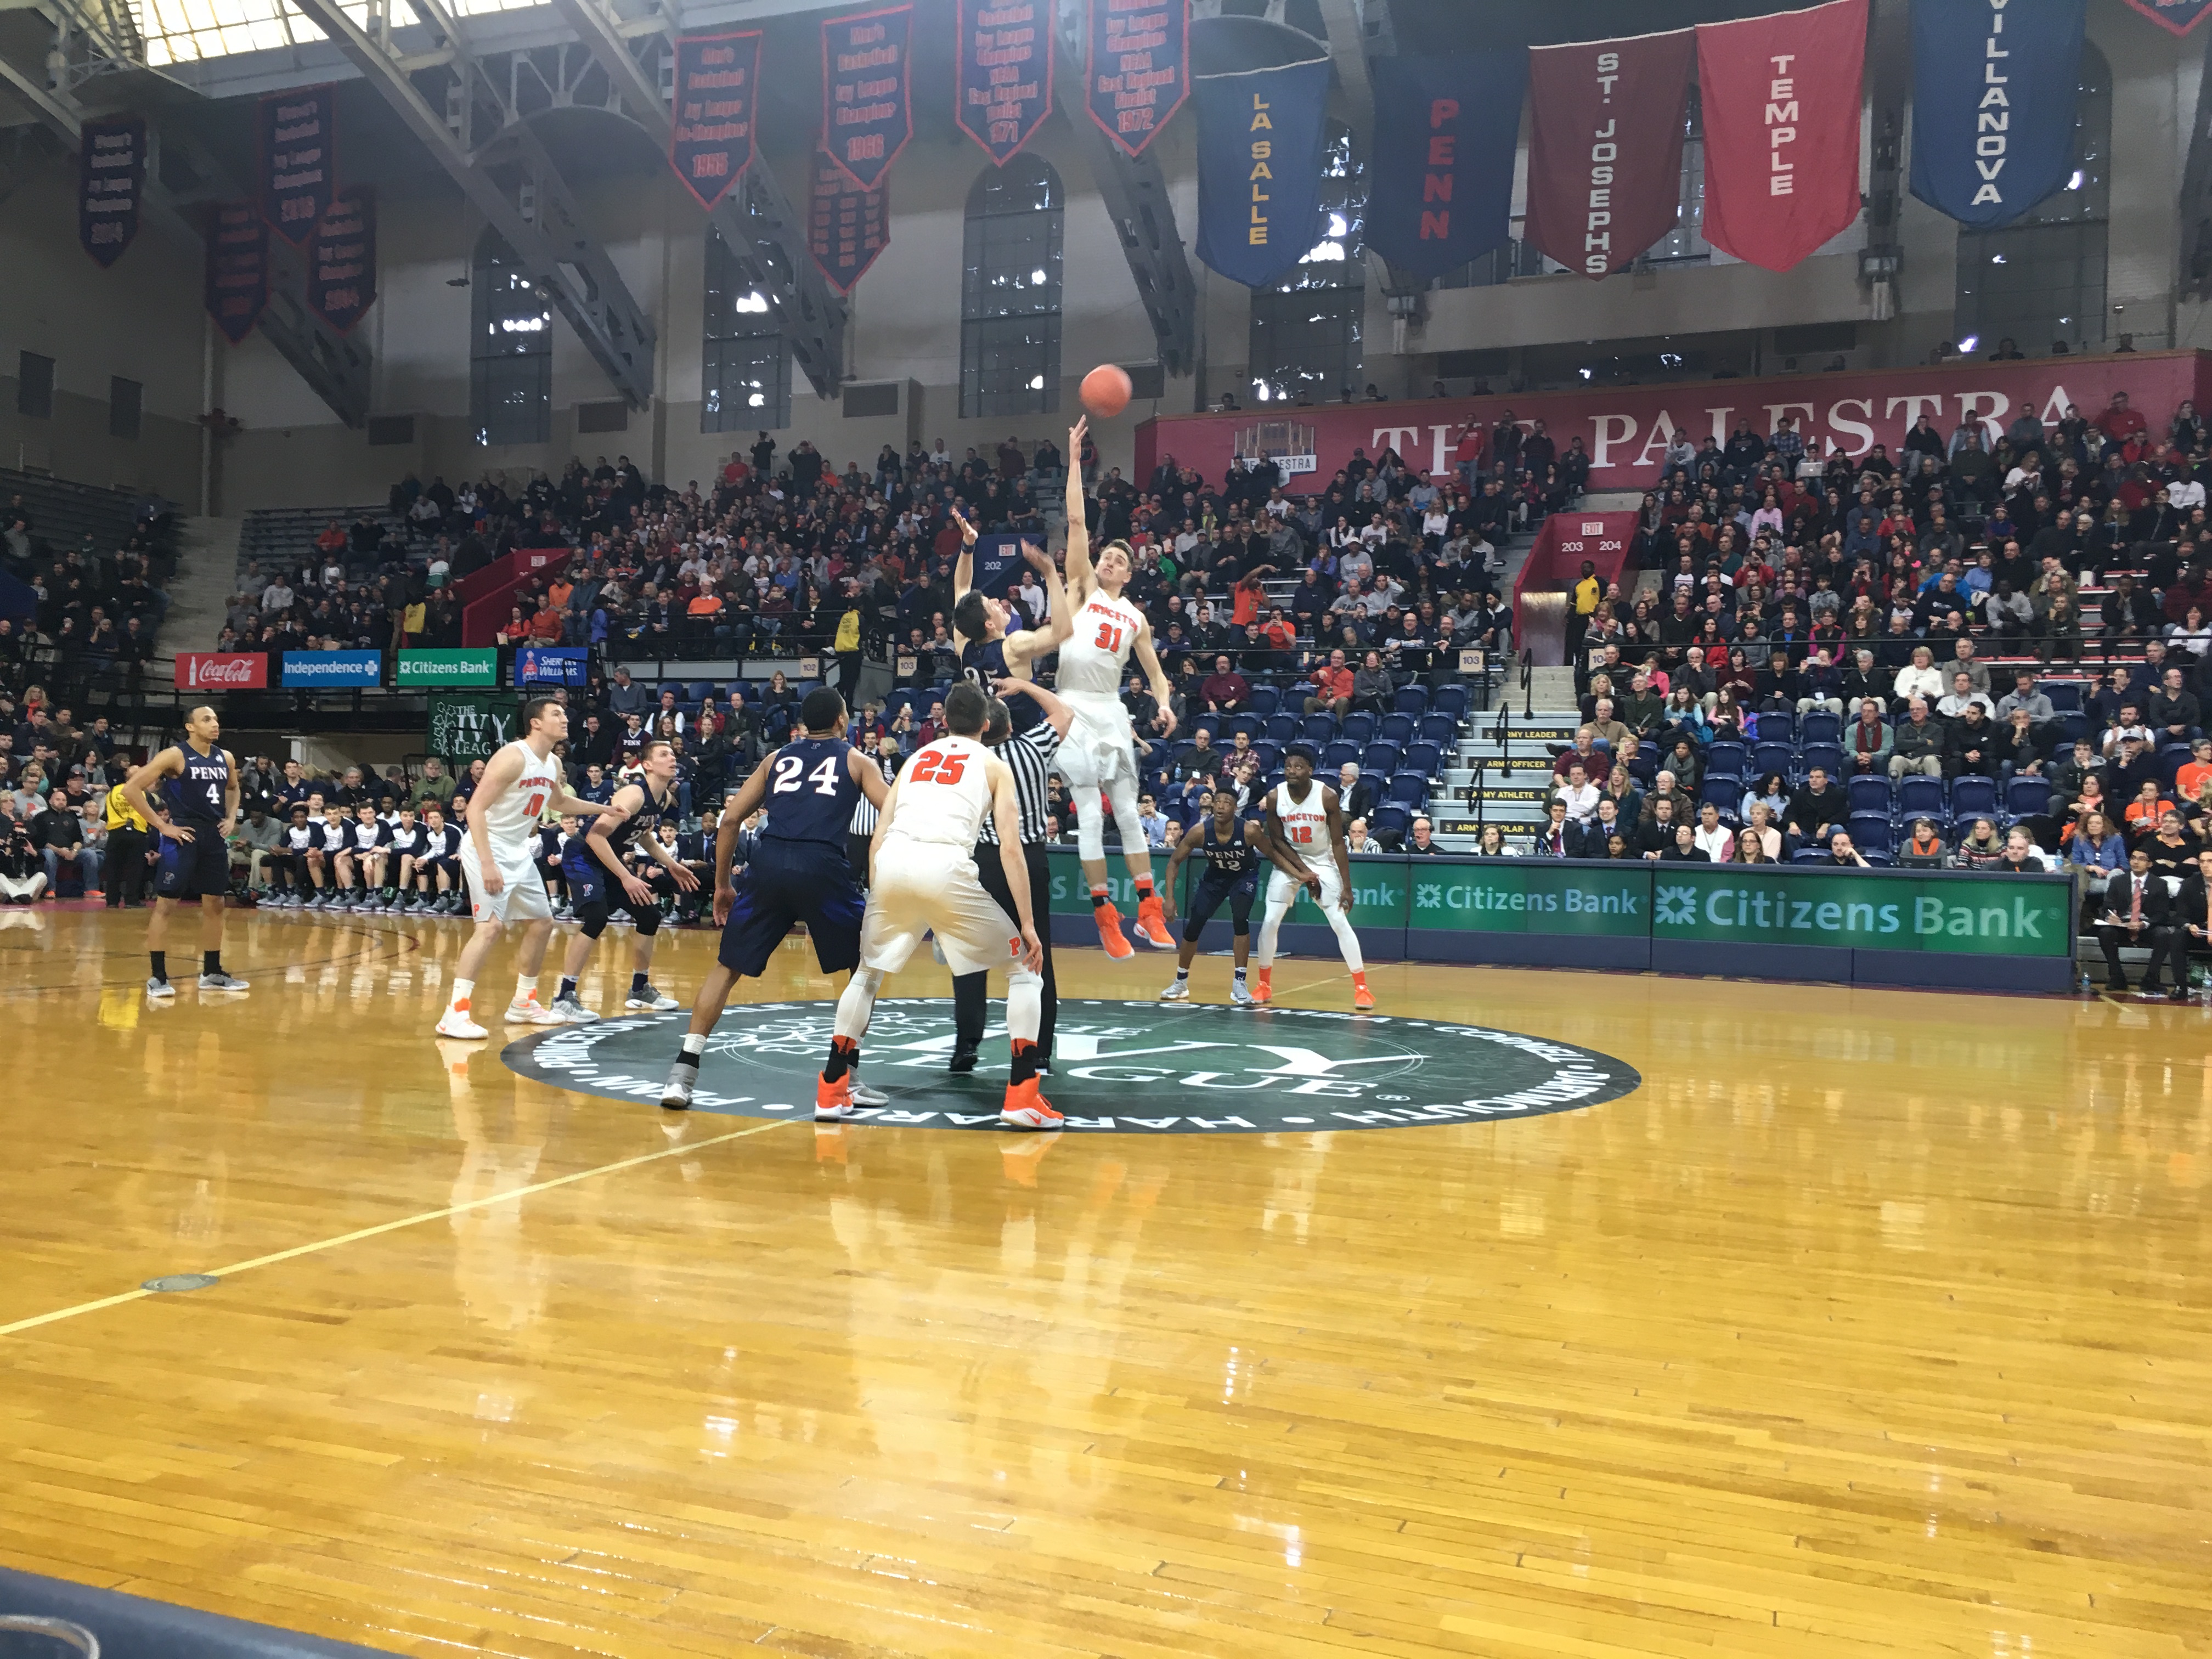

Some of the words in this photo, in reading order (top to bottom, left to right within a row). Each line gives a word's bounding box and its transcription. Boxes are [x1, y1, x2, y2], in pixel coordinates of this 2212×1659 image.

[1596, 53, 1619, 104] ST.
[1118, 108, 1154, 133] 1972
[1250, 93, 1273, 132] LA
[1764, 54, 1799, 196] TEMPLE
[1419, 99, 1460, 240] PENN
[1248, 140, 1273, 245] SALLE
[1561, 541, 1584, 552] 203
[1599, 540, 1622, 551] 204
[984, 561, 1002, 570] 202
[1087, 603, 1138, 632] PRINCETON
[1094, 622, 1122, 653] 31
[284, 662, 363, 676] Independence
[411, 661, 458, 674] Citizens
[460, 660, 490, 674] Bank
[900, 662, 914, 670] 103
[1462, 656, 1480, 664] 103
[458, 705, 475, 714] THE
[457, 713, 511, 742] IVY
[455, 741, 492, 755] LEAG
[189, 766, 228, 780] PENN
[773, 756, 839, 796] 24
[909, 750, 970, 786] 25
[206, 783, 220, 804] 4
[522, 793, 545, 817] 10
[1281, 812, 1325, 822] RINCETON
[1291, 826, 1313, 844] 12
[1205, 849, 1246, 859] PENN
[1215, 859, 1242, 871] 12
[1351, 883, 1395, 906] ank
[1446, 885, 1558, 912] Citizens
[1565, 888, 1638, 914] Bank
[1705, 888, 1900, 933] Citizens
[1914, 896, 2043, 939] Bank
[1008, 936, 1021, 957] P
[1122, 1001, 1392, 1023] COLUMBIA
[532, 1019, 664, 1068] PRINCETON
[1433, 1026, 1595, 1063] CORNELL
[1329, 1069, 1611, 1124] DARTMOUTH
